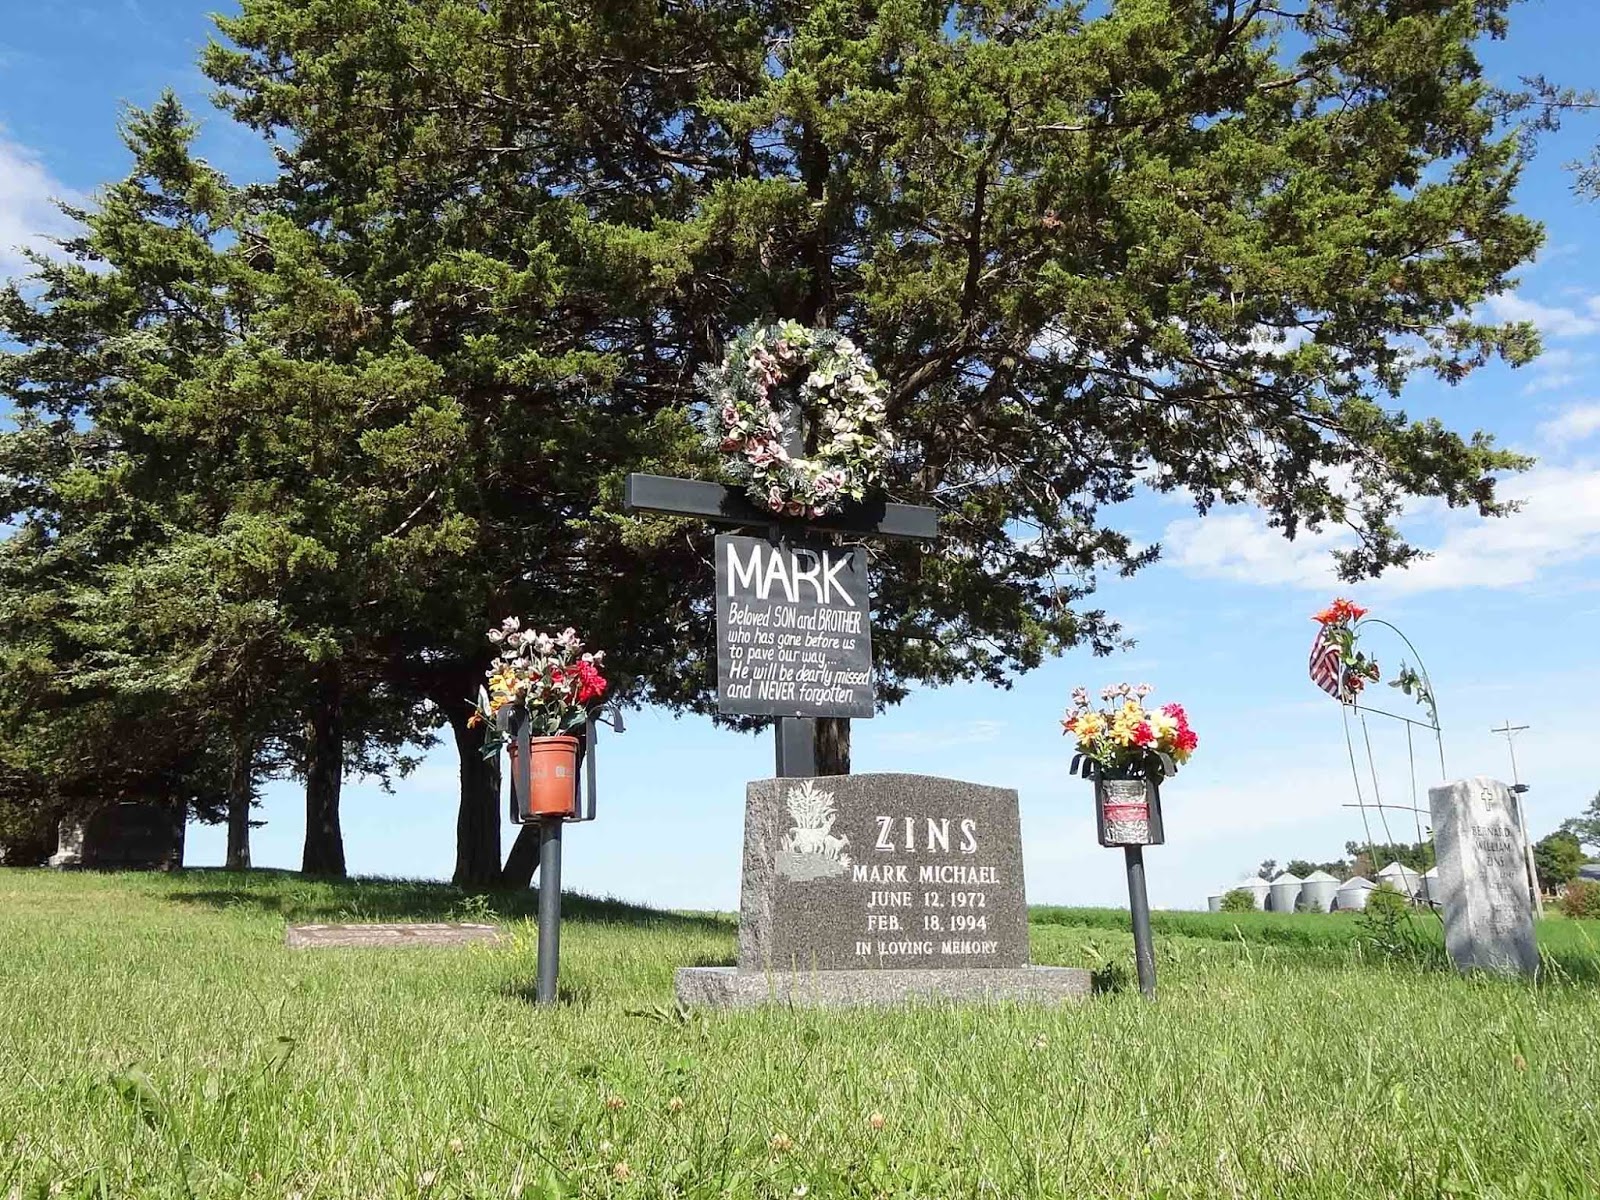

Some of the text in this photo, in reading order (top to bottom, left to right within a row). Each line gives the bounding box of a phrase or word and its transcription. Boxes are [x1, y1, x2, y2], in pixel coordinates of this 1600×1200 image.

[727, 543, 856, 606] MARK
[728, 602, 862, 634] Beloved SON and BROTHER
[727, 626, 856, 650] who has gone before us
[729, 644, 743, 659] to
[746, 647, 774, 665] pave
[778, 649, 800, 662] our
[729, 660, 872, 686] He will be dearly missed
[726, 678, 752, 699] and
[758, 680, 795, 701] NEVER
[875, 815, 978, 854] ZINS
[853, 864, 1000, 885] MARK MICHAEL
[867, 891, 913, 908] JUNE
[951, 892, 986, 908] 1972
[868, 914, 904, 931] FEB.
[951, 915, 987, 931] 1994
[855, 941, 998, 955] IN LOVING MEMORY
